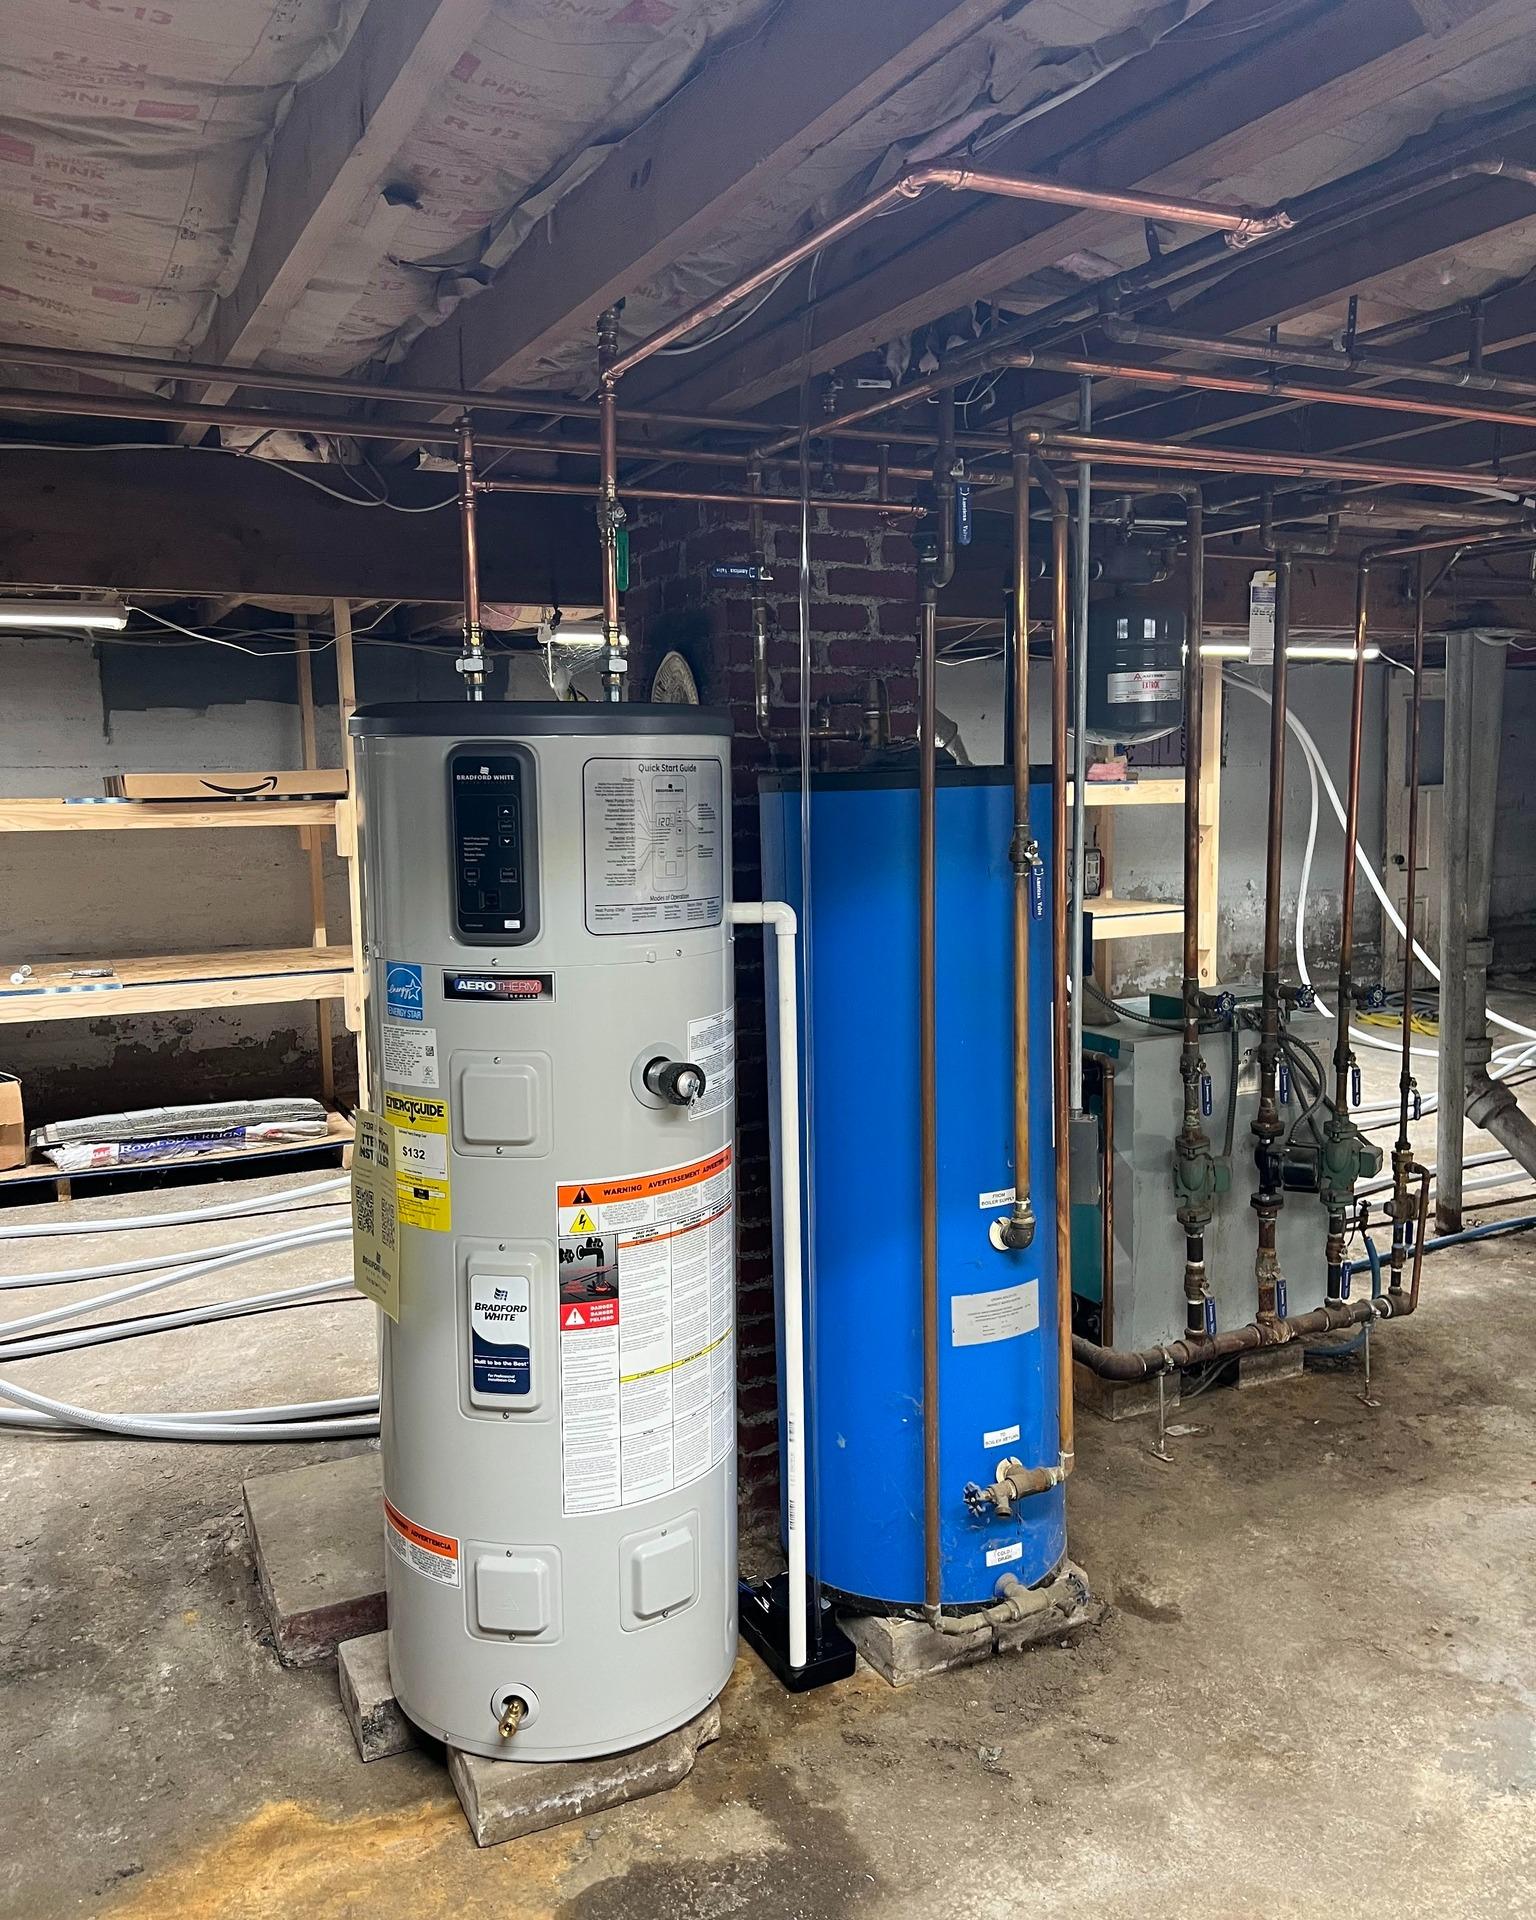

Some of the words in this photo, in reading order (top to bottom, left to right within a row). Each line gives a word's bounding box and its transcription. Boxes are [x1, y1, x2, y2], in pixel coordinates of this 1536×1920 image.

[638, 763, 660, 773] Quick
[661, 764, 678, 772] Start
[679, 764, 697, 773] Guide
[458, 980, 539, 993] AEROTHERM
[388, 1006, 406, 1017] ENERGY
[407, 1009, 422, 1019] STAR
[120, 1141, 164, 1154] ROYAL
[402, 1145, 425, 1160] $132
[603, 1184, 642, 1196] WARNING
[648, 1169, 700, 1188] AVERTISSEMENT
[474, 1302, 527, 1313] BRADFORD
[484, 1312, 516, 1321] WHITE
[589, 1315, 614, 1323] PELIGRO
